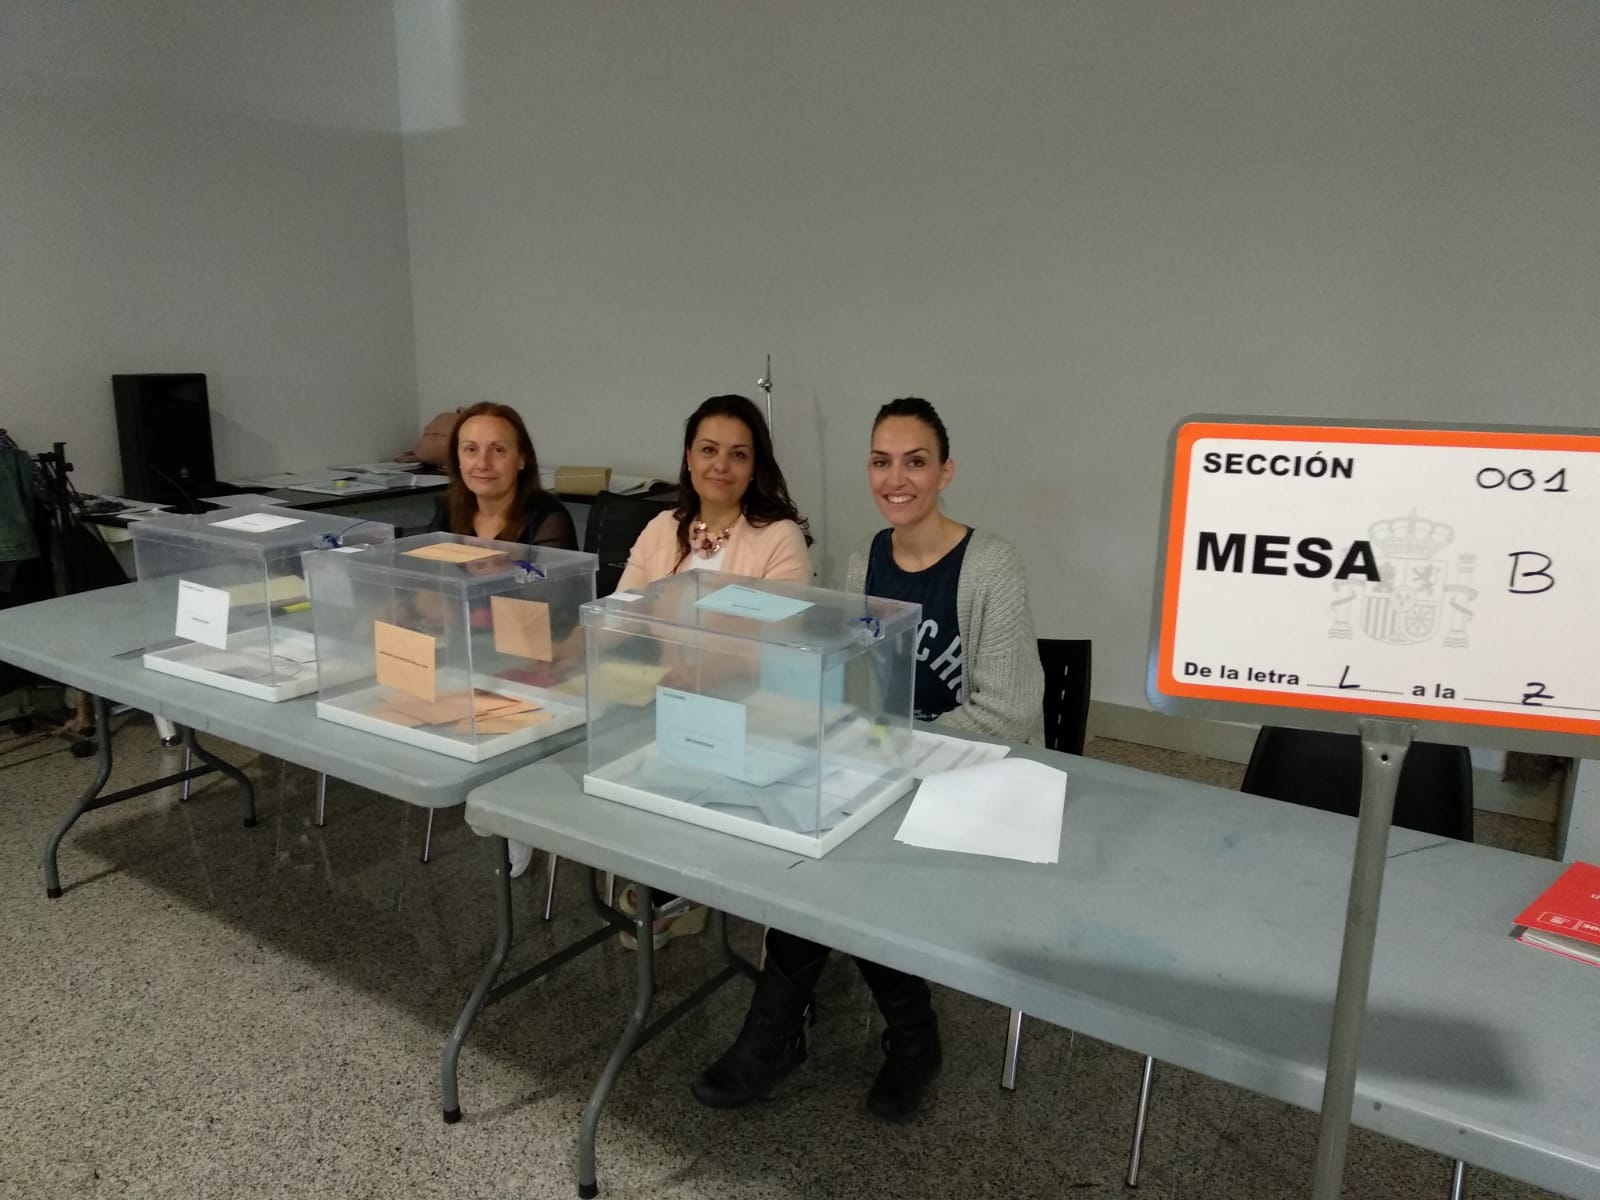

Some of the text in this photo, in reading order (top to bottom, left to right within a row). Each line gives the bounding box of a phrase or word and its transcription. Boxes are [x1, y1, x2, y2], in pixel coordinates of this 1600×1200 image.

[1203, 451, 1569, 493] SECCIÓN 001
[1196, 531, 1555, 595] MESA B
[1184, 661, 1212, 678] De
[1220, 665, 1239, 681] la
[1247, 667, 1300, 686] letra
[1338, 665, 1361, 690] L
[1412, 684, 1426, 698] a
[1434, 683, 1456, 700] la
